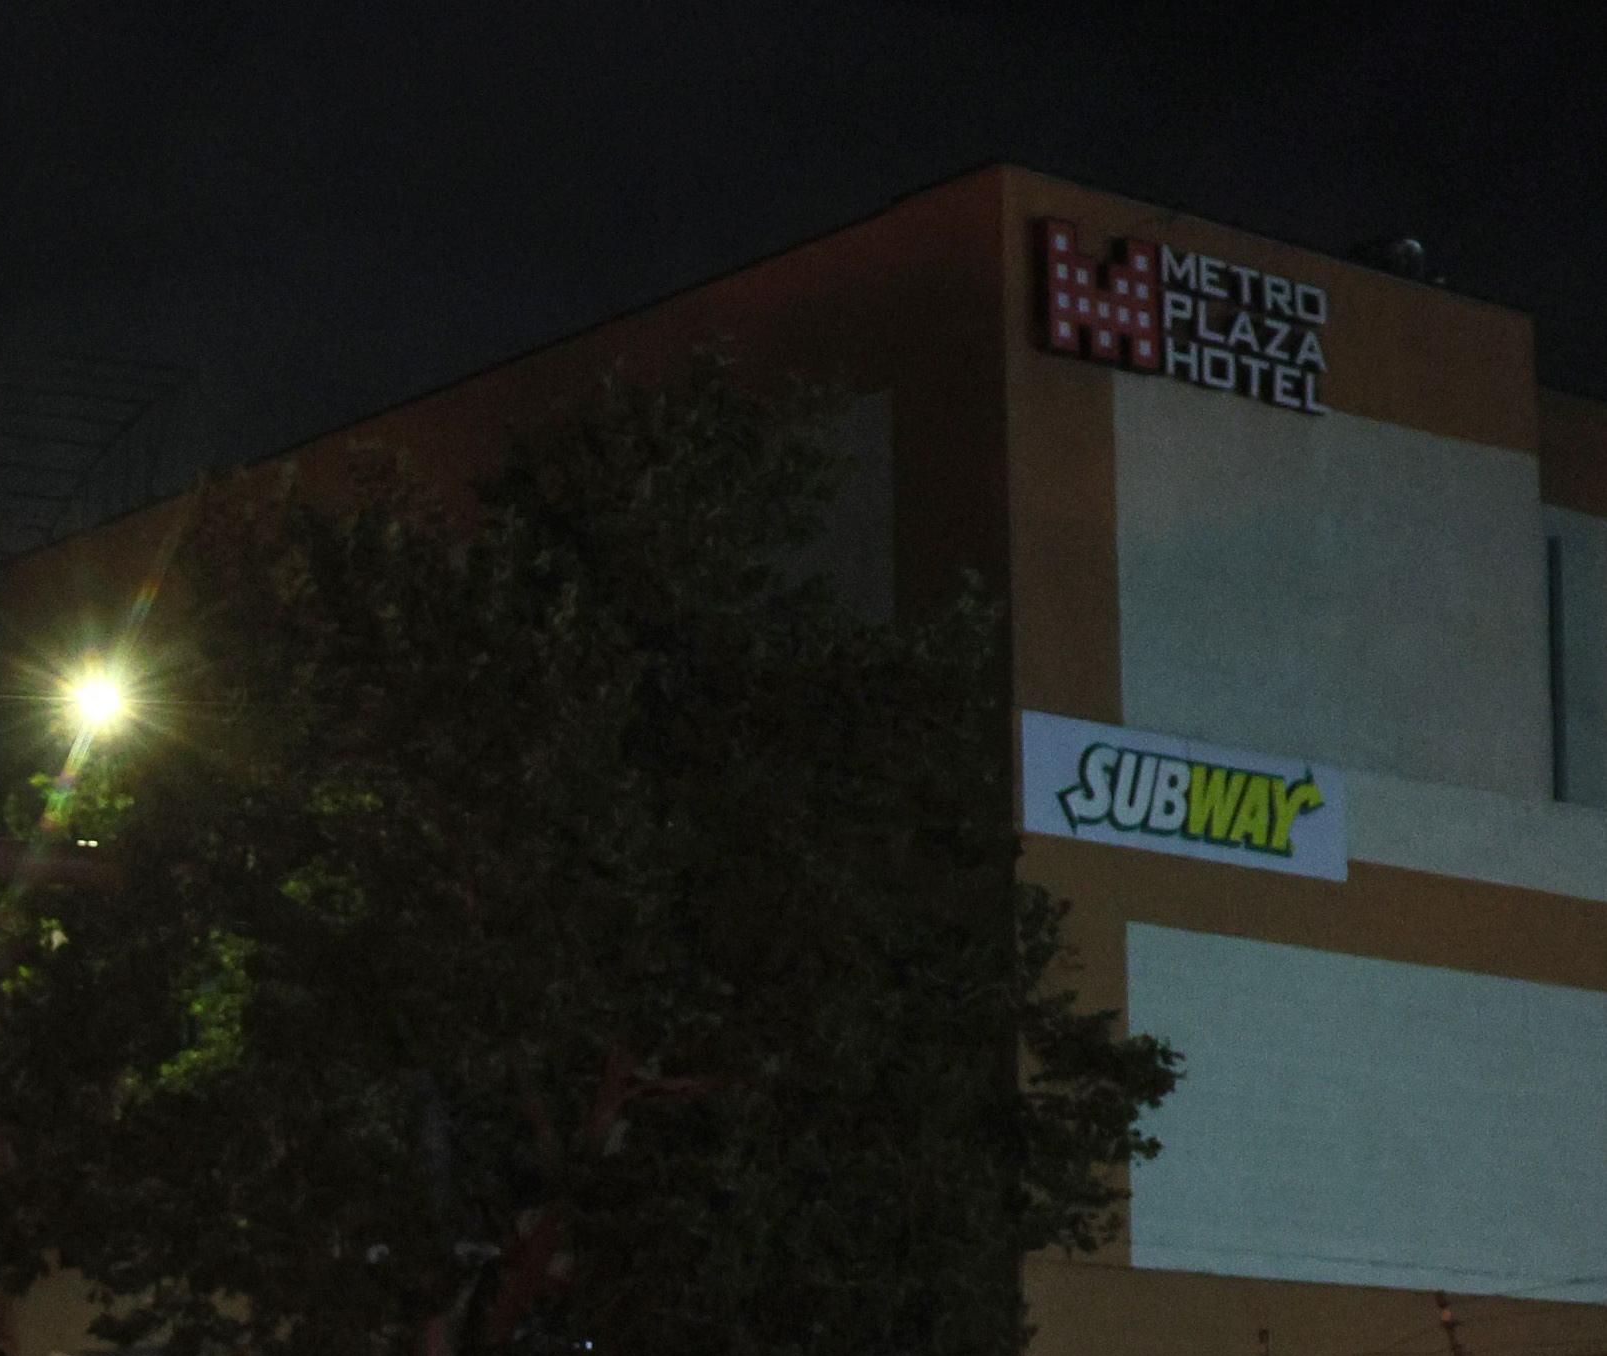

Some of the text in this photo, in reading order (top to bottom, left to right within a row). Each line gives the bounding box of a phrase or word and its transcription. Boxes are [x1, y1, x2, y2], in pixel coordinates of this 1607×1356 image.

[1160, 243, 1328, 325] METRO
[1162, 290, 1328, 372] PLAZA
[1164, 336, 1330, 414] HOTEL
[1056, 742, 1324, 857] SUBWAY
